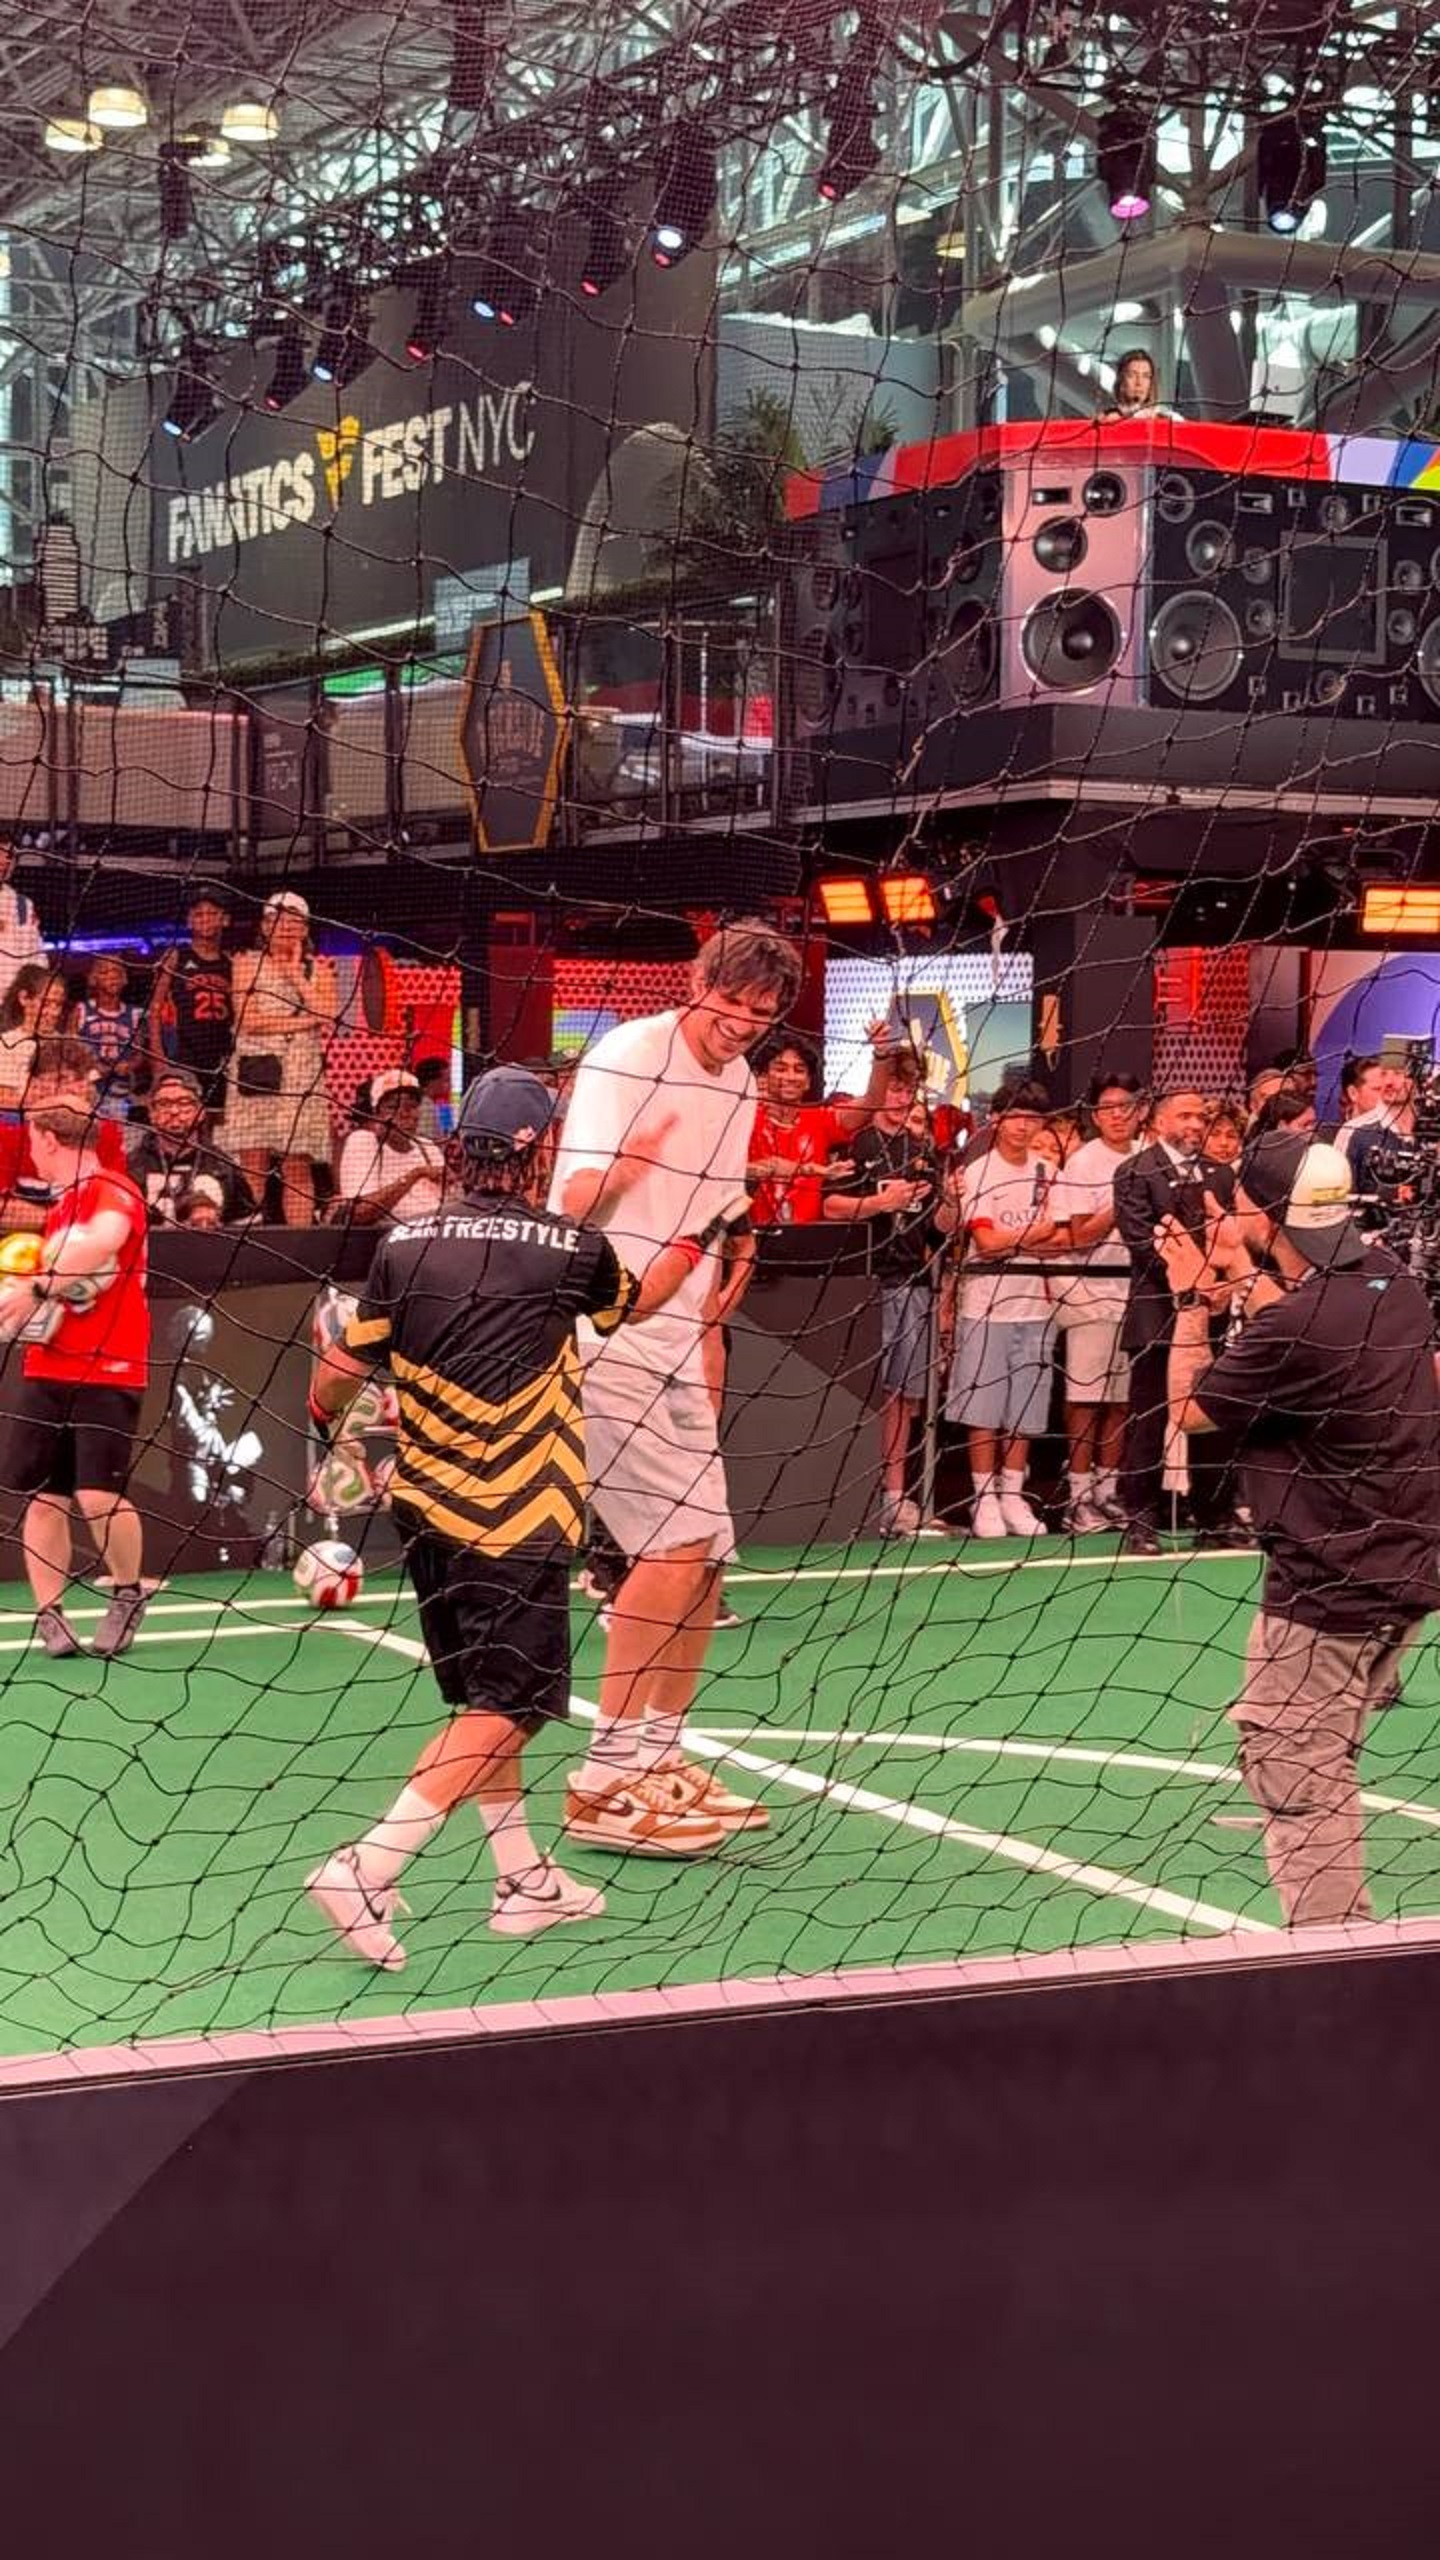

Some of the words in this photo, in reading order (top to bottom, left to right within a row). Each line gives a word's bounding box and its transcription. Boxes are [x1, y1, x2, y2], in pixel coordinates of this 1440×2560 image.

[168, 452, 315, 563] FANATICS
[362, 406, 453, 505] FEST
[458, 390, 535, 474] NYC
[195, 991, 228, 1019] 25
[442, 1215, 580, 1253] FREESTYLE
[1000, 1209, 1050, 1228] QAT
